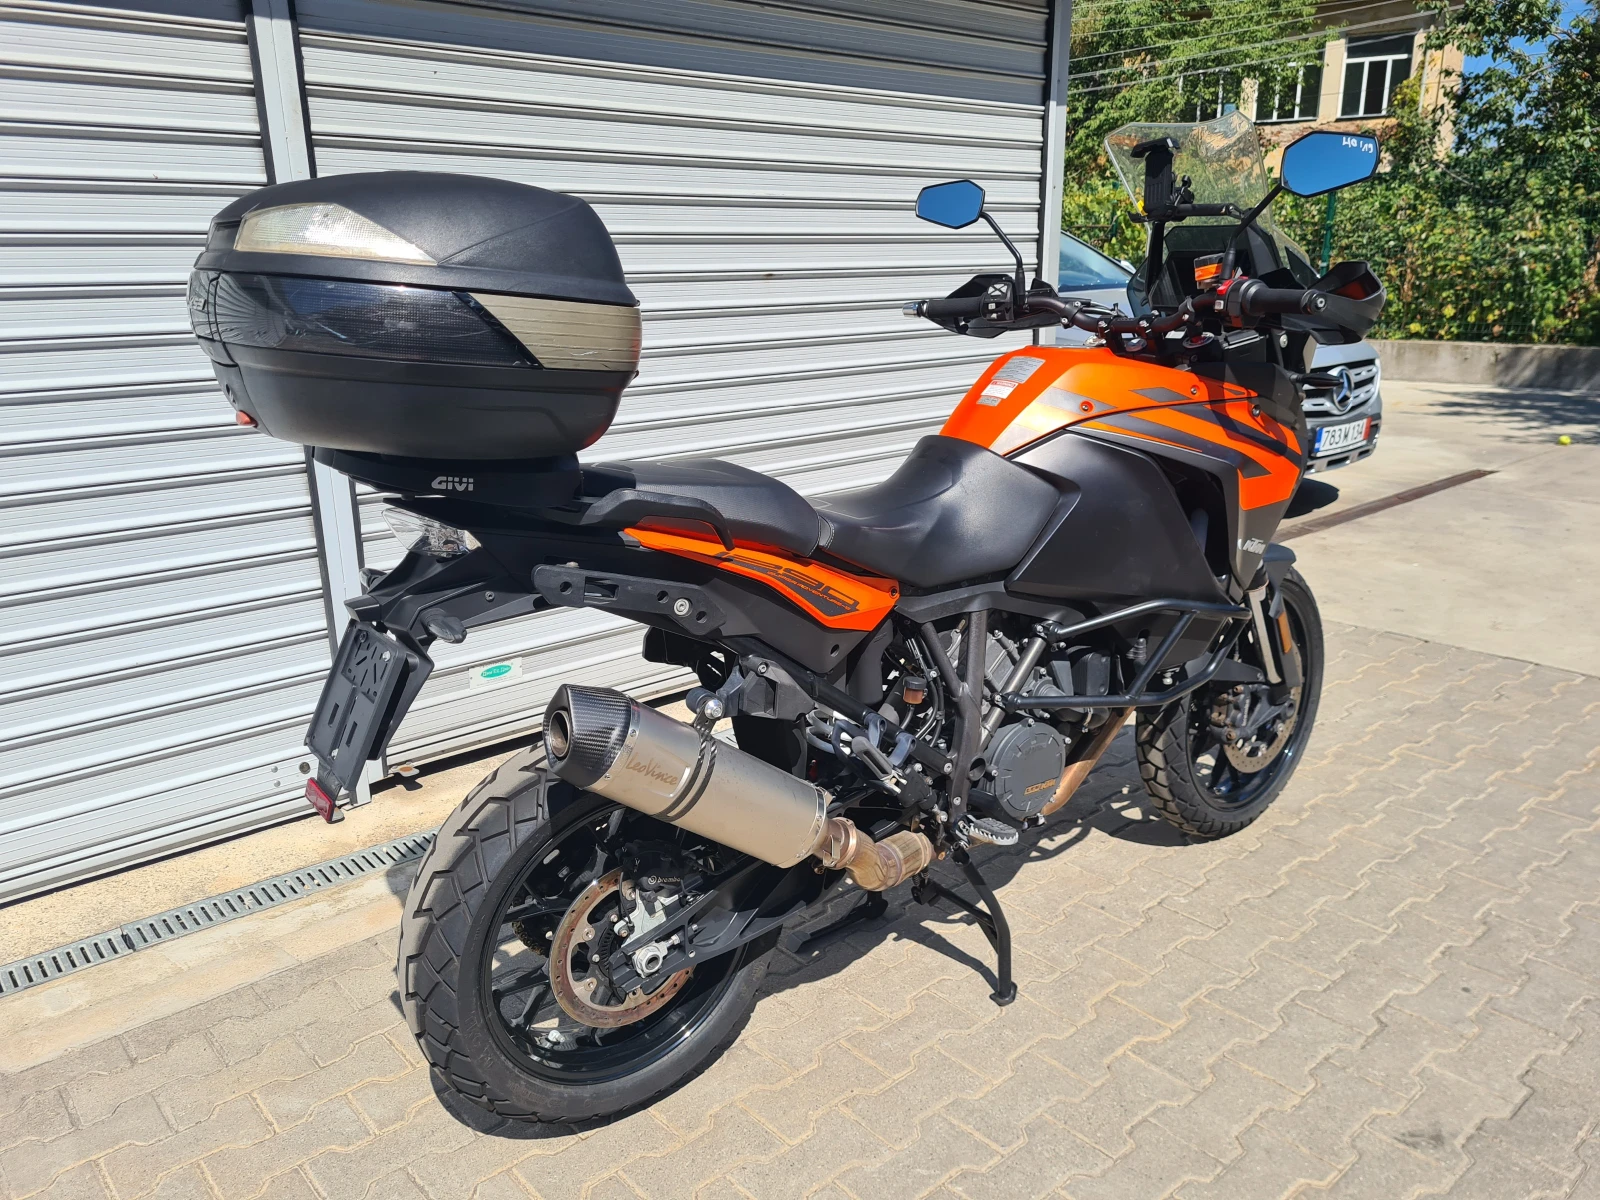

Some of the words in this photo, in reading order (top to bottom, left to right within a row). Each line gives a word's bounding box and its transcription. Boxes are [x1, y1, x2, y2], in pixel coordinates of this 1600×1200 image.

[1322, 430, 1342, 448] 783
[431, 476, 474, 491] GIVI
[1242, 537, 1266, 555] KTM
[625, 752, 679, 786] LeoVince
